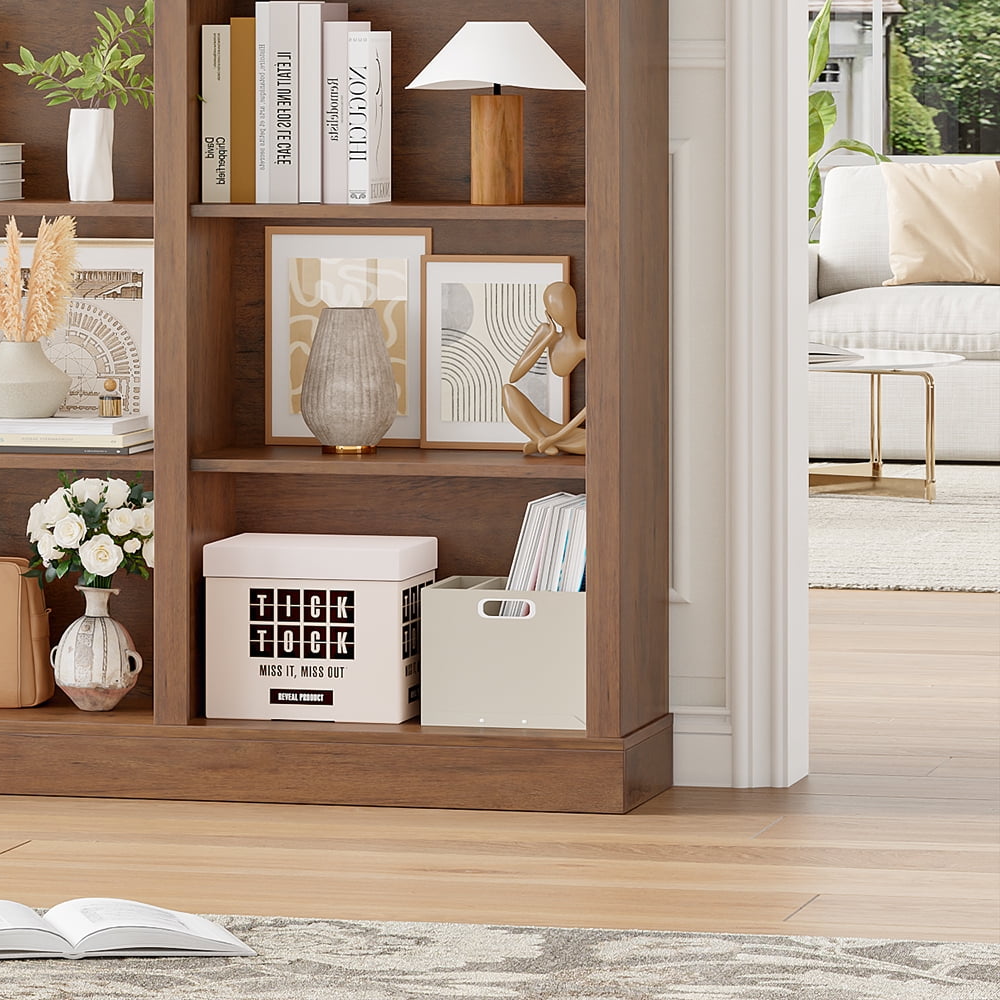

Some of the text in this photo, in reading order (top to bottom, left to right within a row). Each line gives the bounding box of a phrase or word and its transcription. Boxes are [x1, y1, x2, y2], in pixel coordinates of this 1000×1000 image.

[256, 594, 348, 619] TICK
[256, 629, 348, 655] TOCK
[259, 664, 345, 679] MISS IT, MISS OUT
[277, 692, 299, 702] REVEAL
